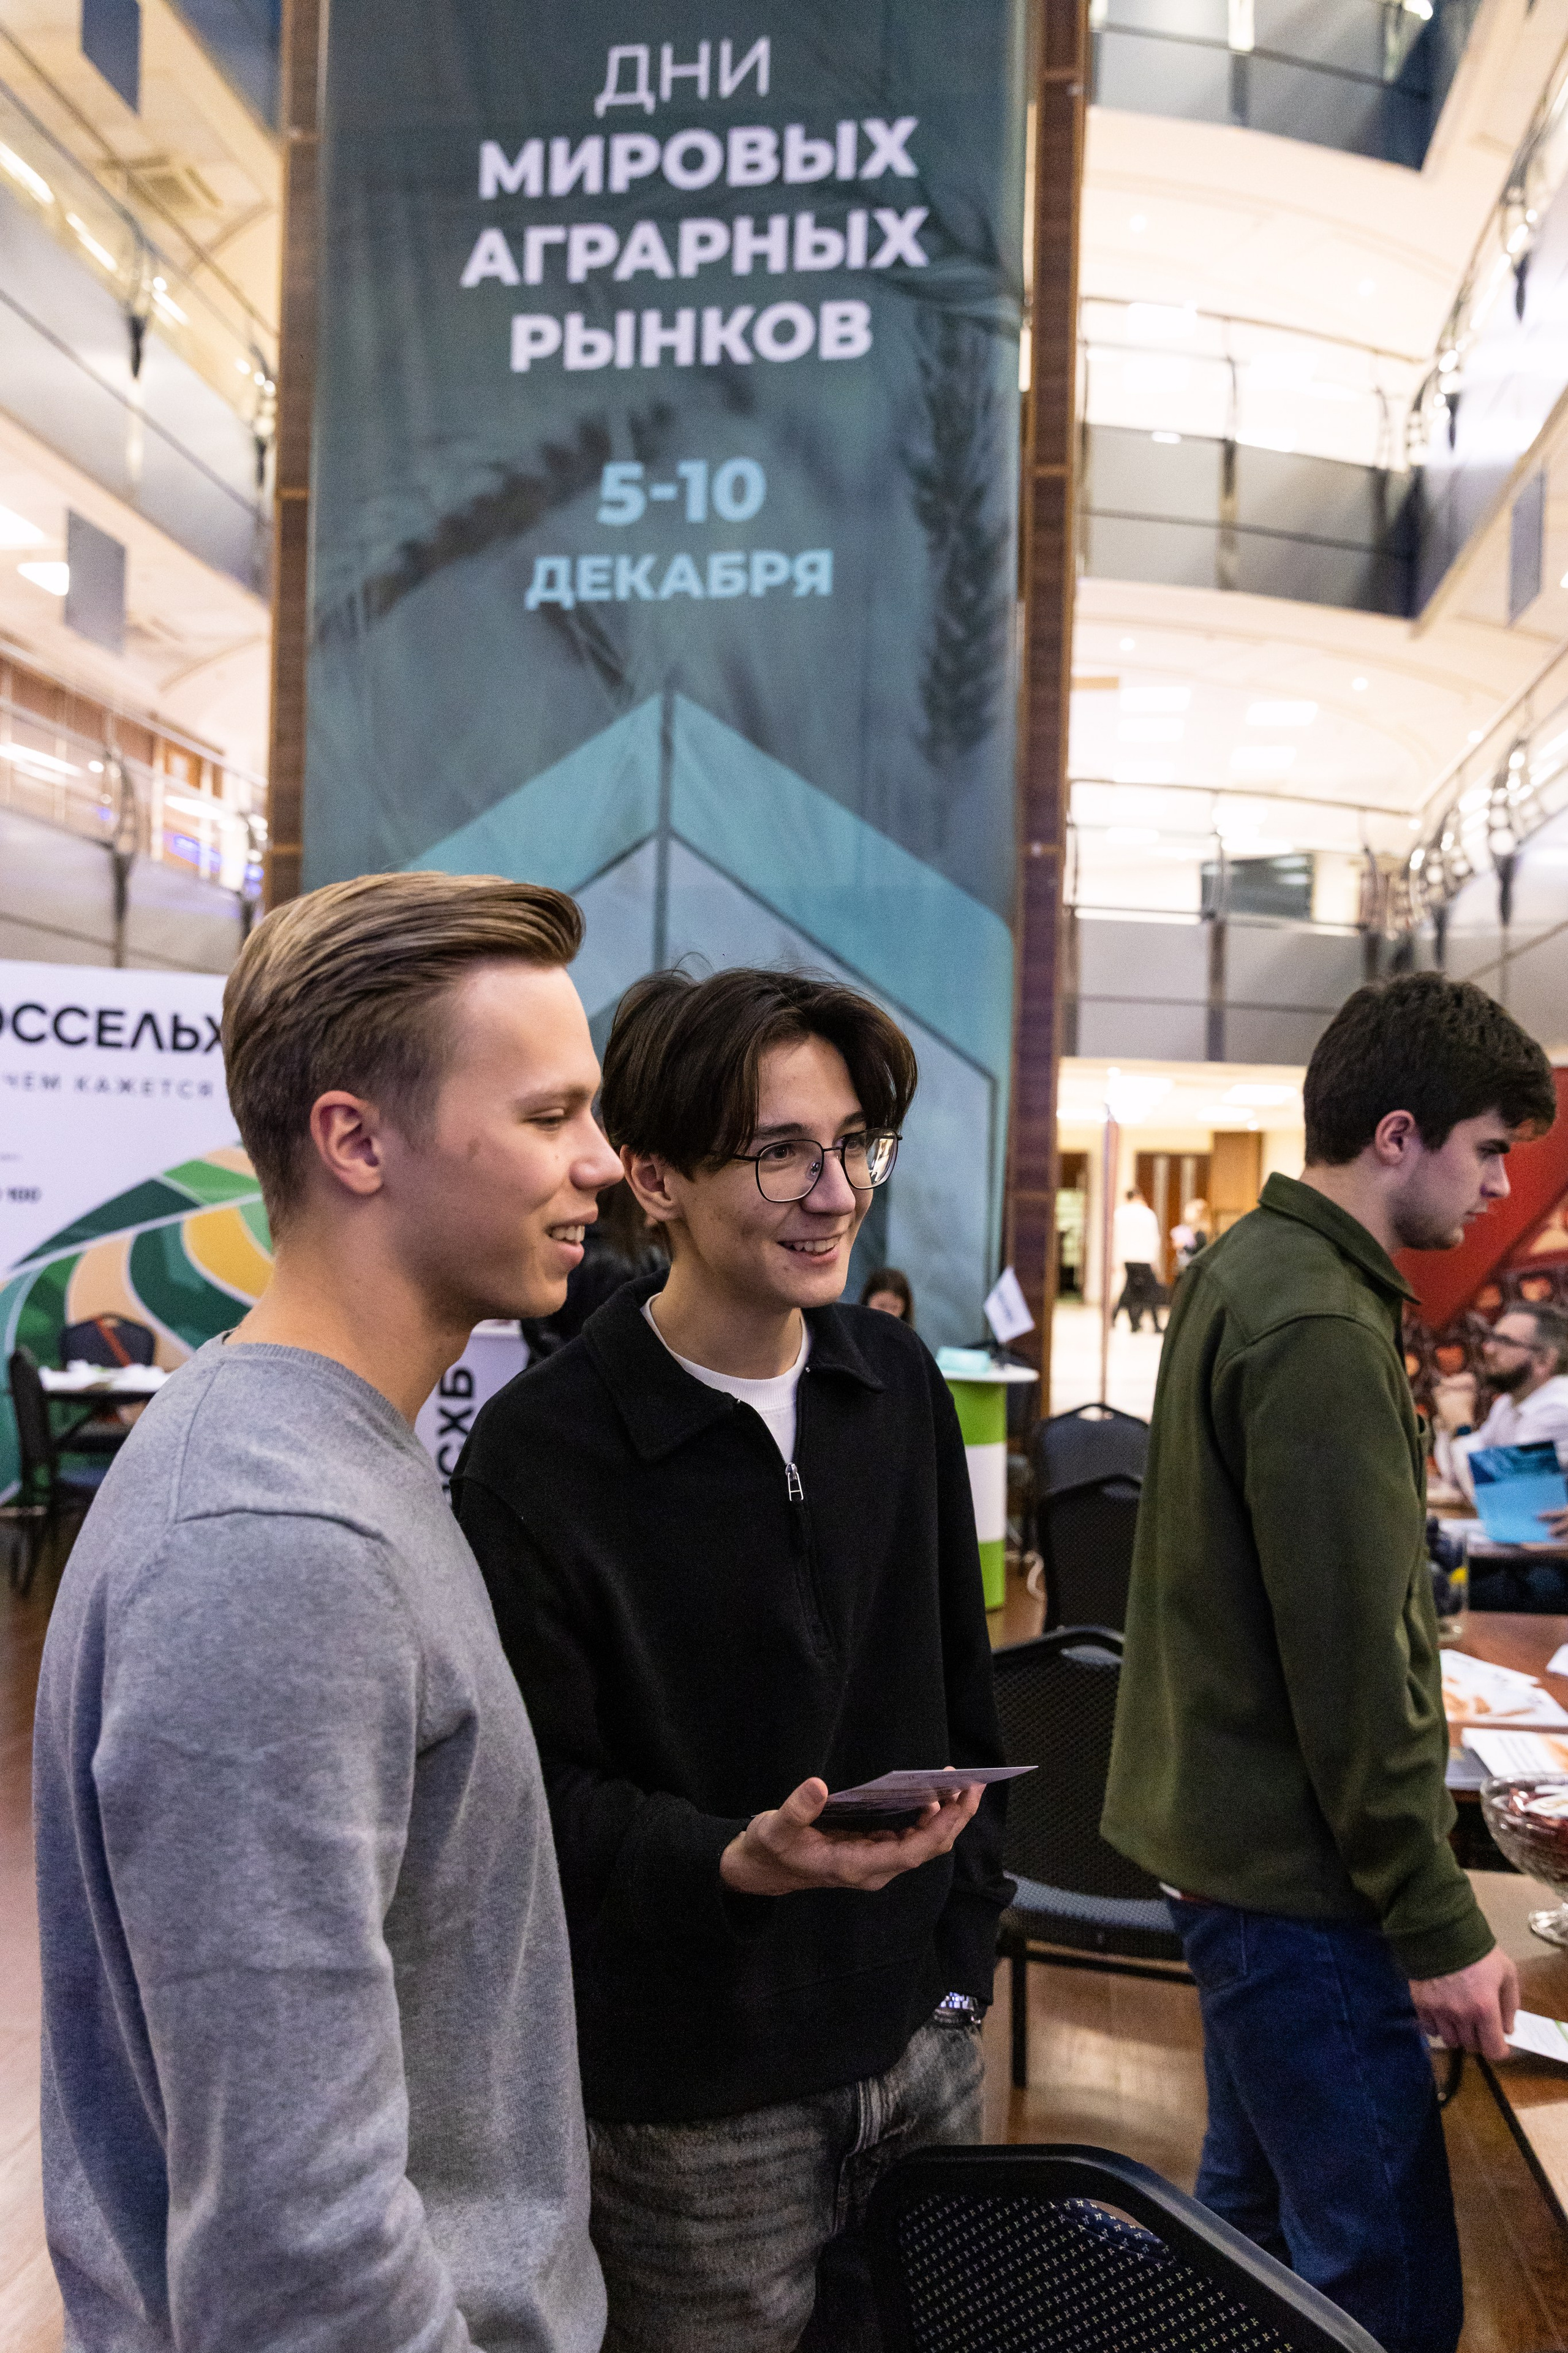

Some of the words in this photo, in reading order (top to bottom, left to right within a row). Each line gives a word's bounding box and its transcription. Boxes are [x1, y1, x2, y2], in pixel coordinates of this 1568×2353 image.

[594, 37, 771, 117] ДНИ
[479, 116, 919, 199] МИРОВЫХ
[460, 207, 929, 287] АГРАРНЫХ
[511, 299, 872, 371] РЫНКОВ
[597, 458, 766, 526] 5-10
[525, 549, 834, 611] ДЕКАБРЯ
[0, 1003, 221, 1054] ССЕЛЬХ
